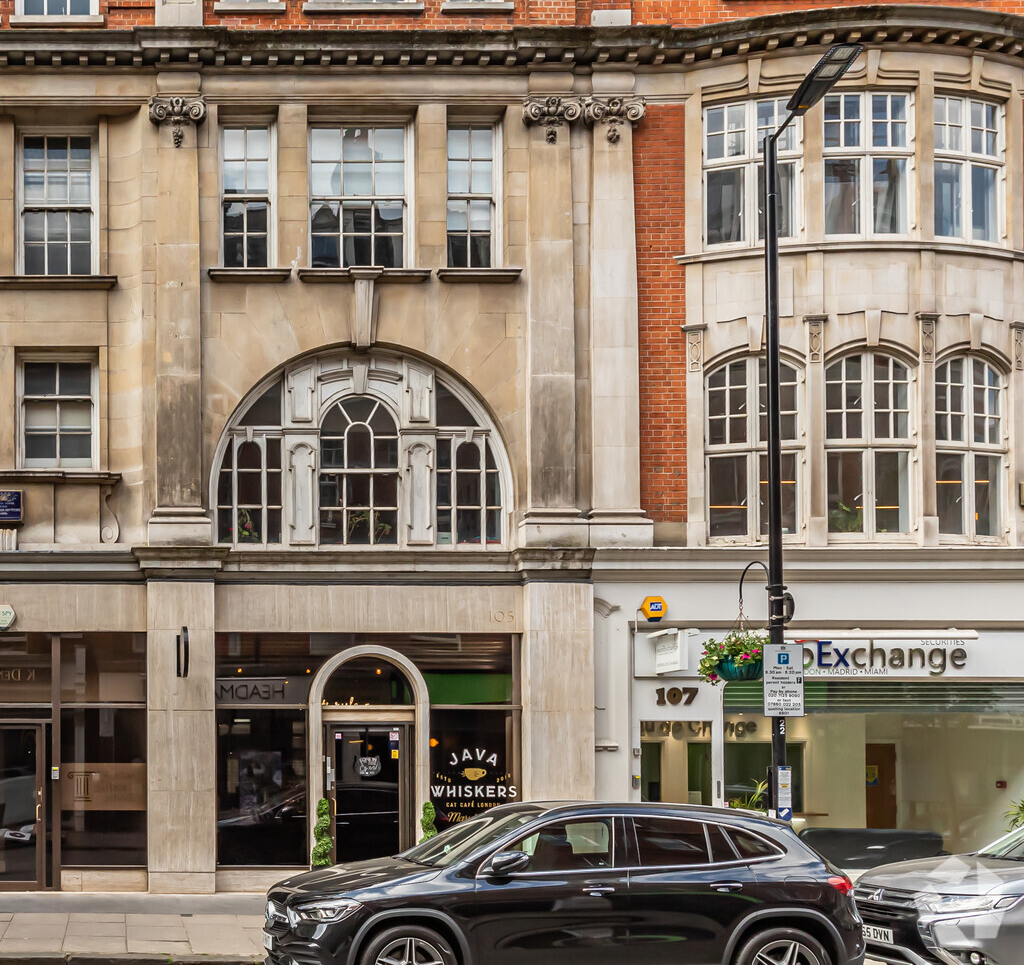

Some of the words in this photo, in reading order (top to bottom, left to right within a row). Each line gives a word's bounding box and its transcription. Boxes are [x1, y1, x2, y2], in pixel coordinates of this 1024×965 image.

[649, 603, 662, 611] ADT
[488, 609, 515, 623] 105
[803, 639, 968, 676] oExchange
[804, 668, 822, 676] DON
[827, 668, 859, 676] MADRID
[864, 668, 889, 676] MIAMI
[656, 687, 699, 707] 107
[449, 748, 498, 767] JAVA
[430, 785, 518, 798] WHISKERS
